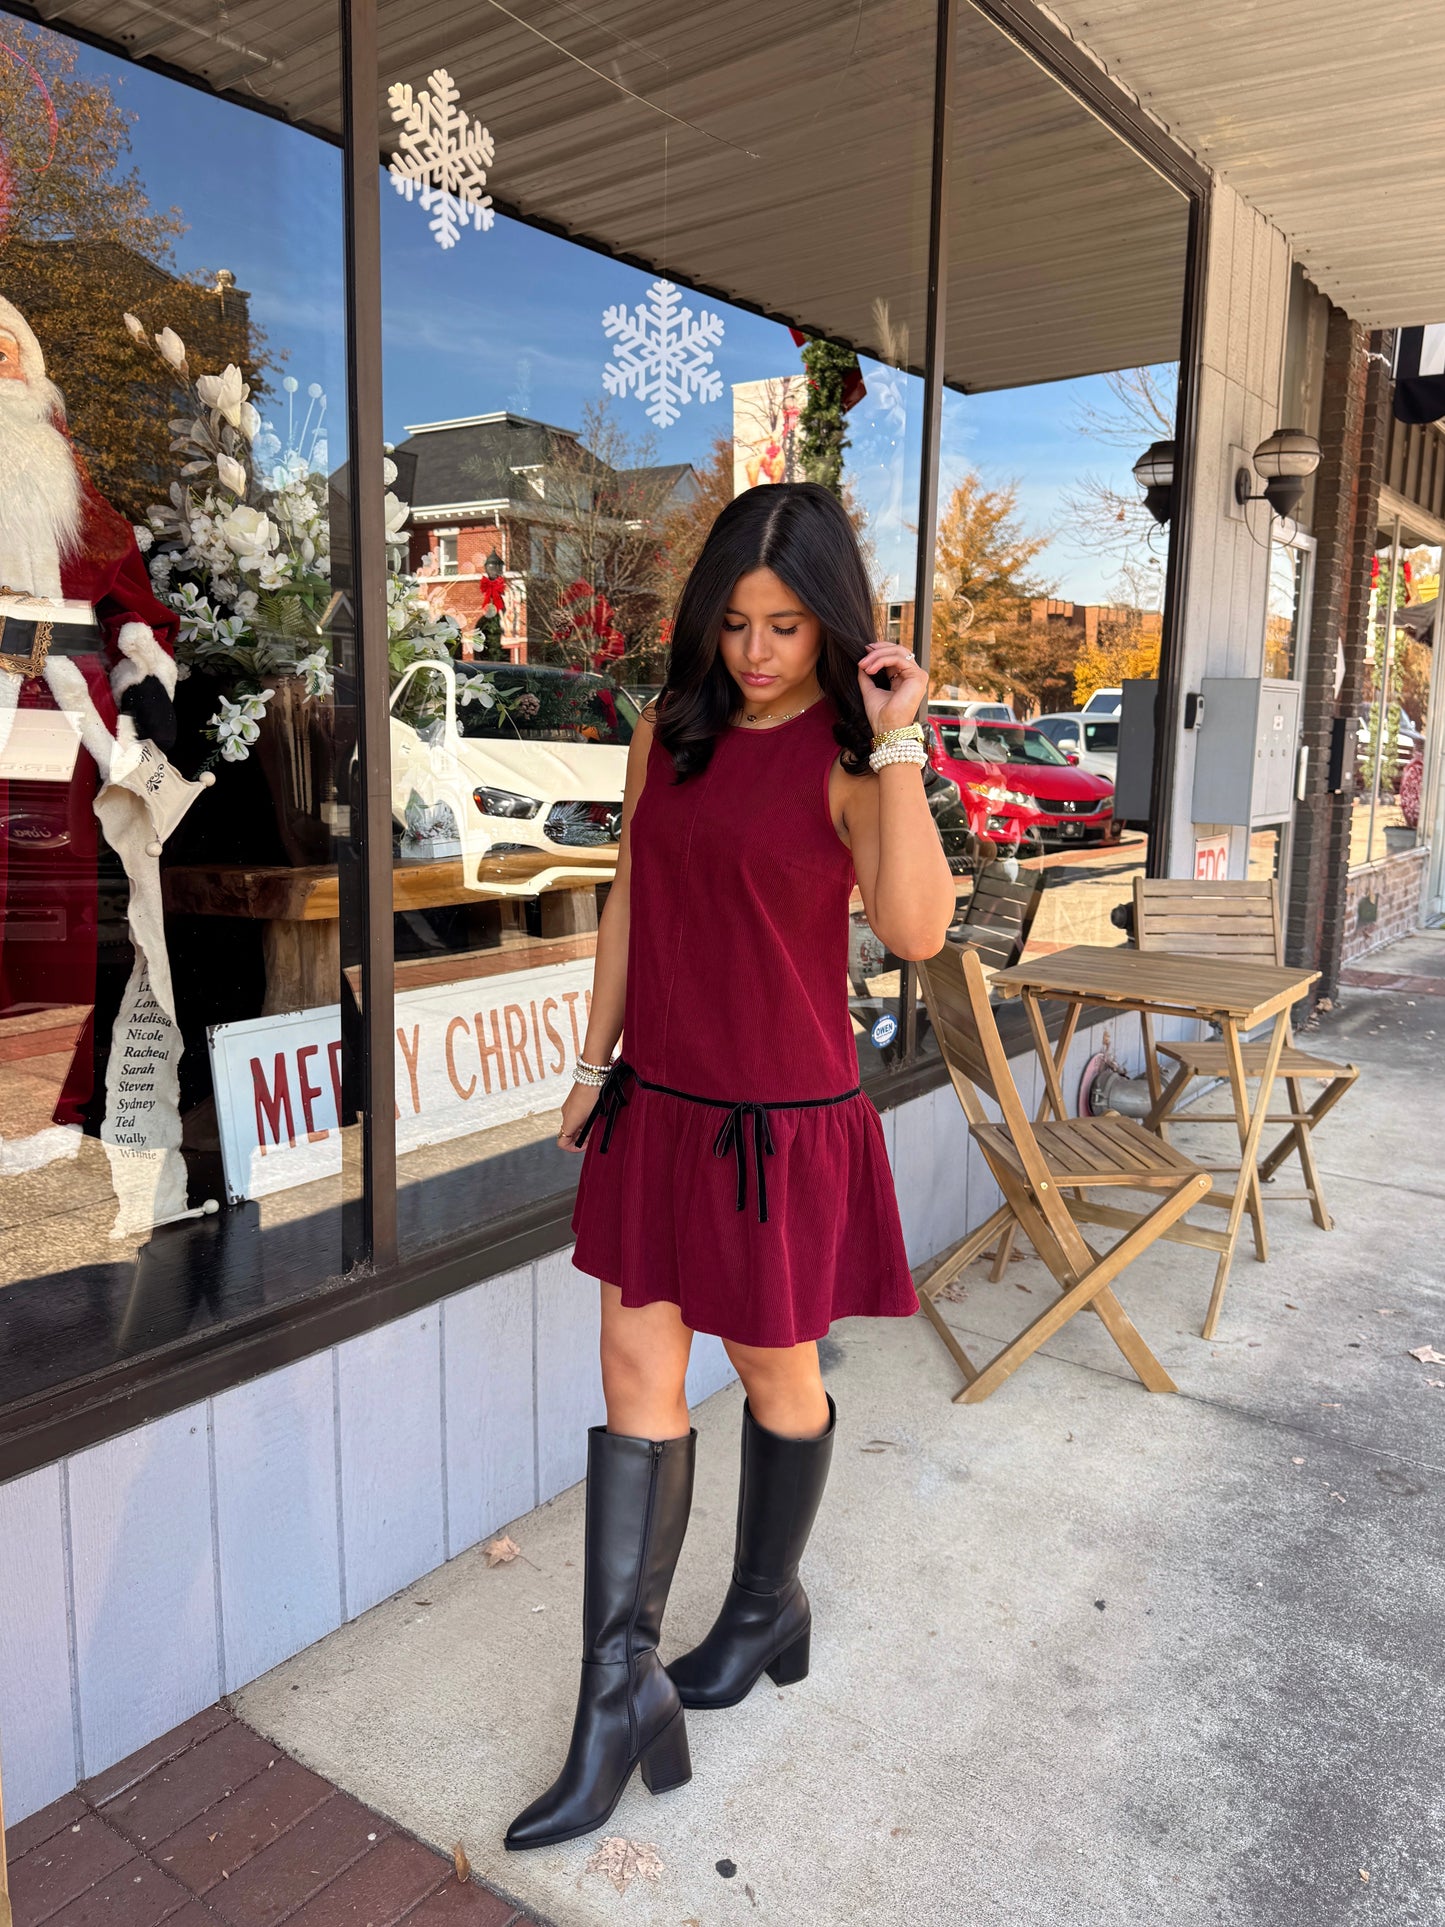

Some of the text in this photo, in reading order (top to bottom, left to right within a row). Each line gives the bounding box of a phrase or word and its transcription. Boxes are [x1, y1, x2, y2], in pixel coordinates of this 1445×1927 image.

[129, 1013, 172, 1027] Melissa
[126, 1029, 163, 1041] Nicole
[123, 1046, 169, 1061] Racheal
[121, 1063, 155, 1075] Sarah
[118, 1081, 154, 1092] Steven
[117, 1098, 155, 1113] Sydney
[115, 1115, 136, 1127] Ted
[115, 1132, 147, 1146] Wally
[119, 1148, 157, 1160] Winnie
